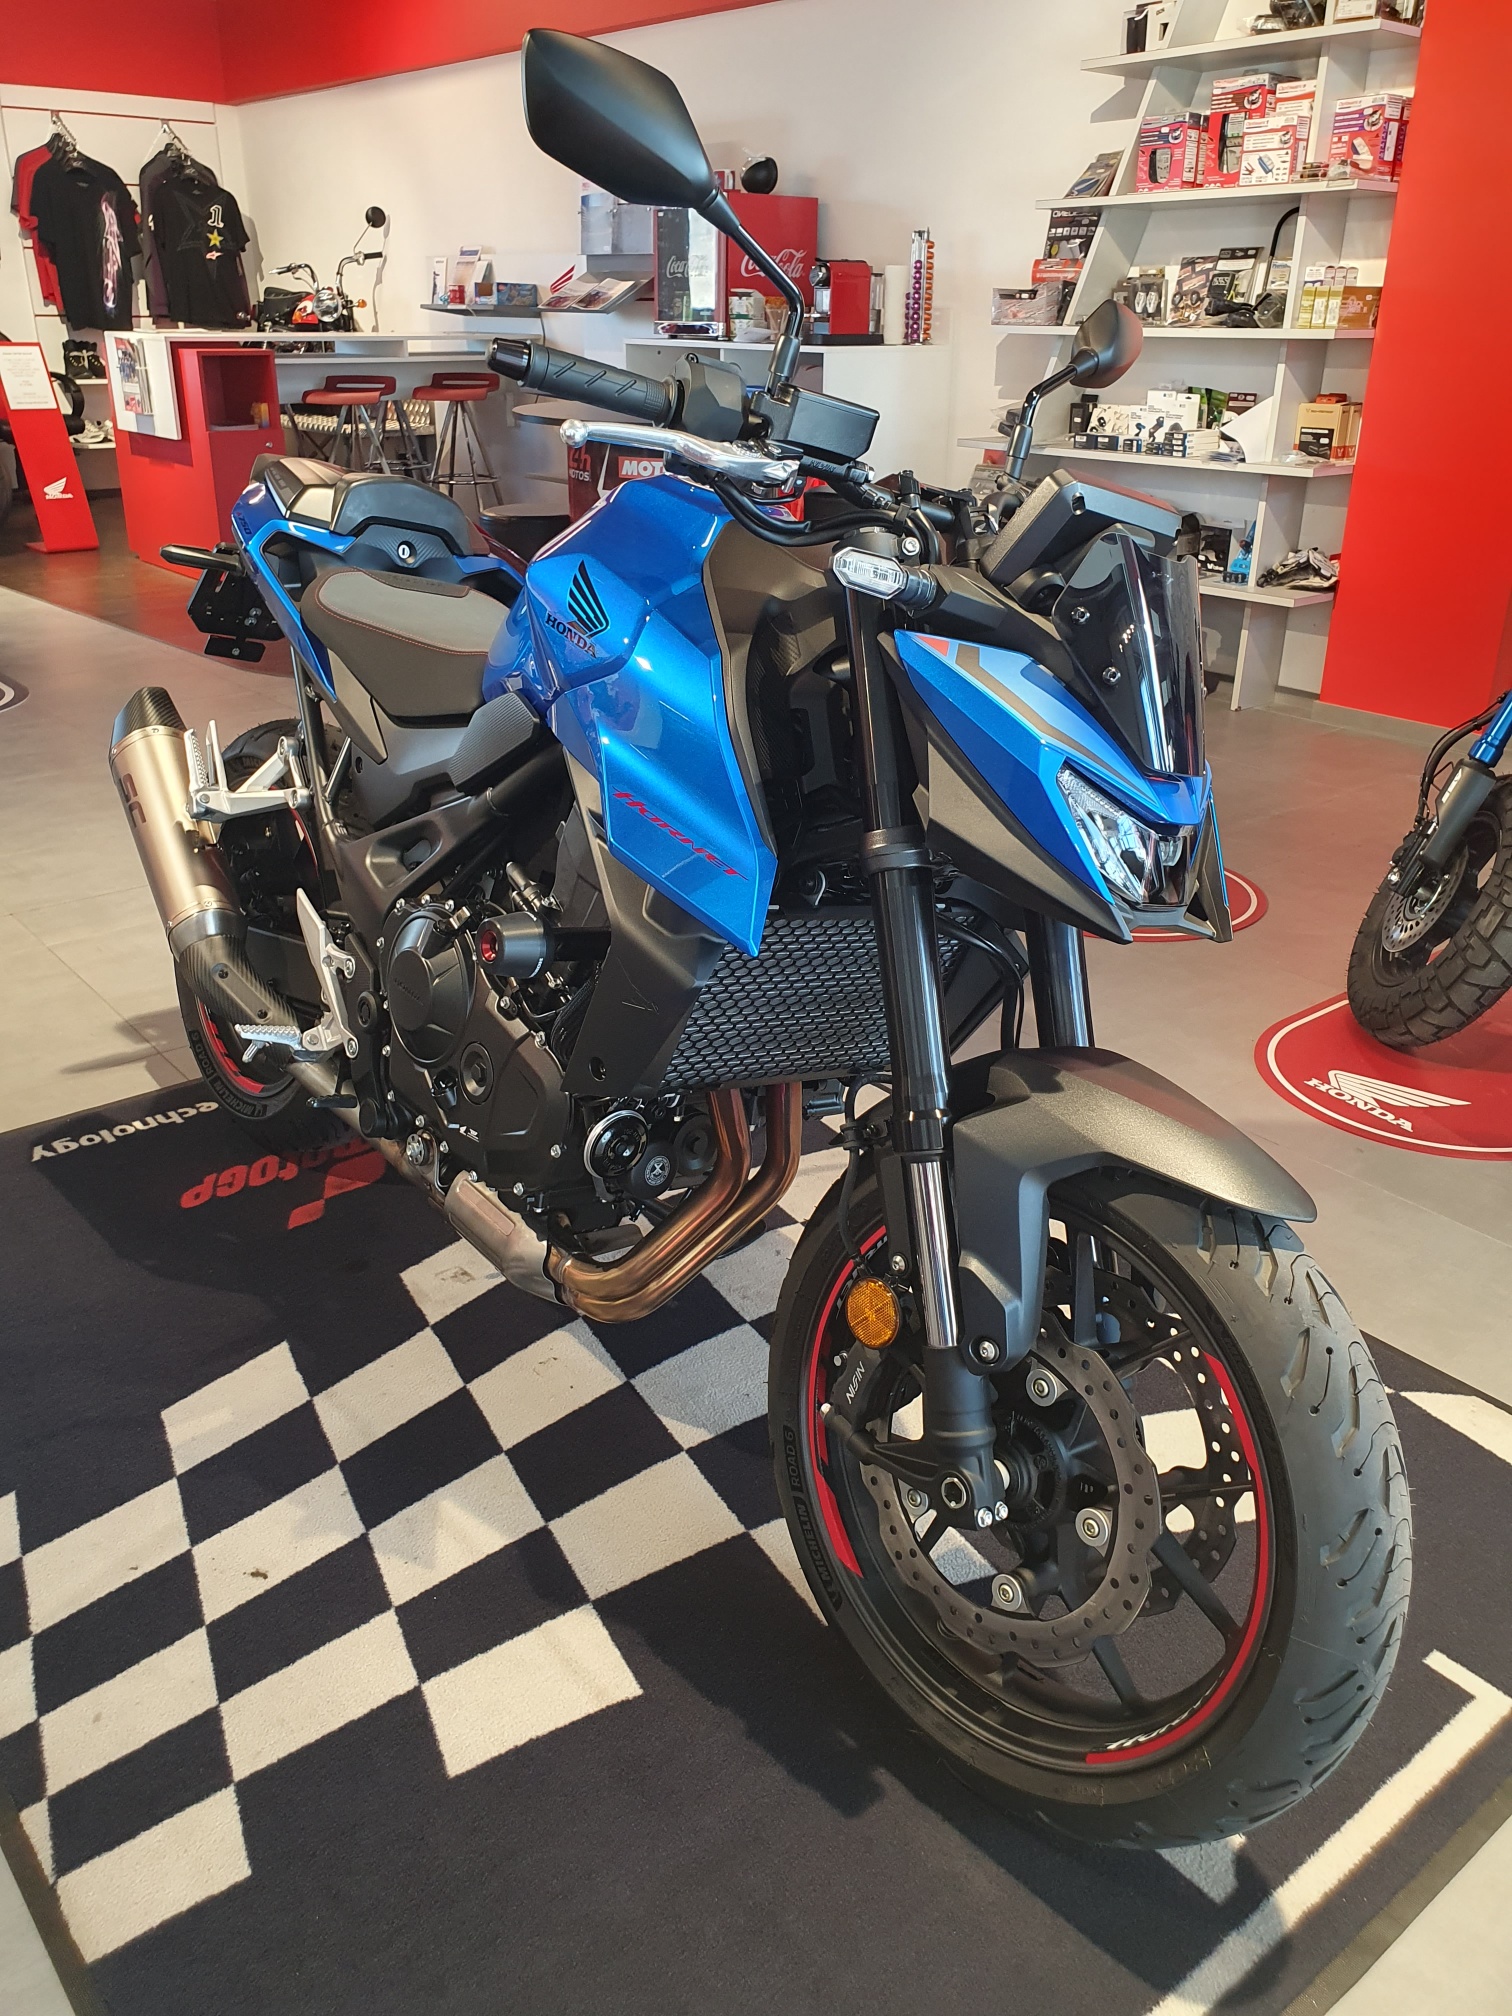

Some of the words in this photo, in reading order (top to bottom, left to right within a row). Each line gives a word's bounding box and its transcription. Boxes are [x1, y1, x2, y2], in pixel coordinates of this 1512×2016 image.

[207, 205, 224, 228] 1
[545, 612, 597, 659] HONDA
[1303, 1077, 1414, 1133] HONDA
[784, 1430, 795, 1443] 6
[785, 1444, 803, 1488] ROAD
[796, 1503, 833, 1584] MICHELIN
